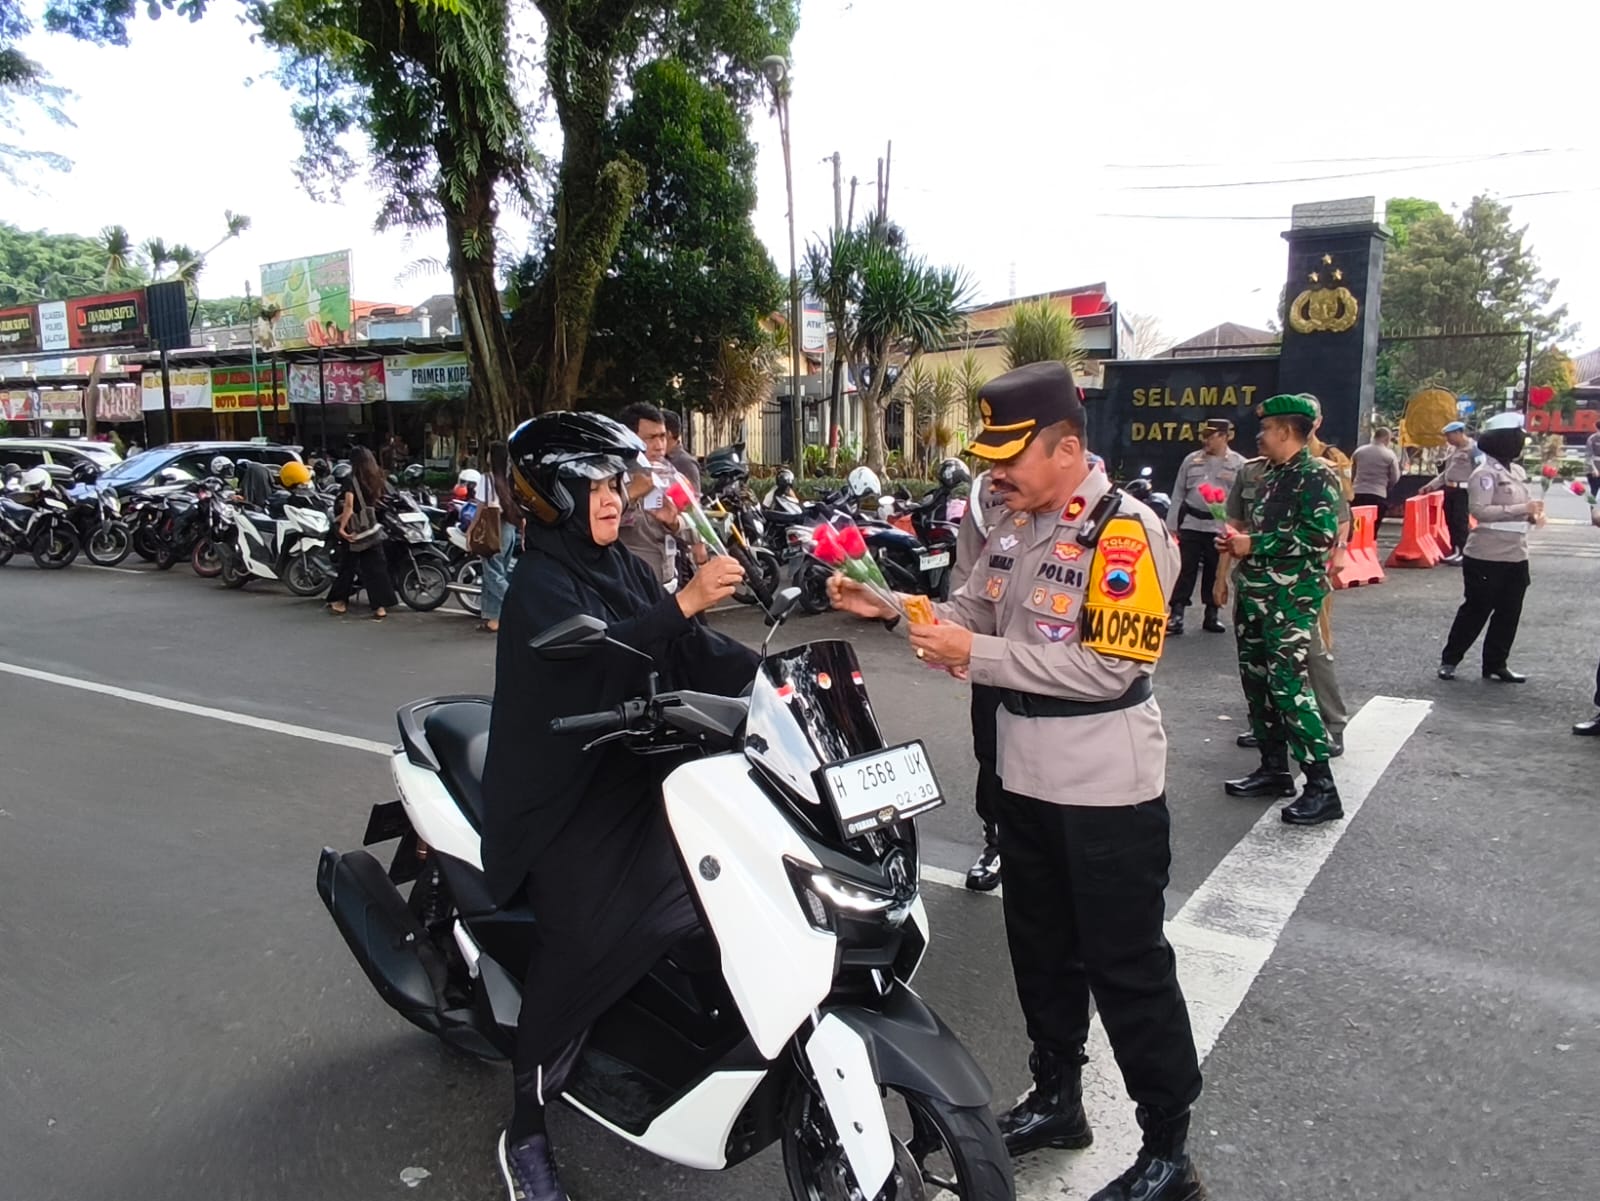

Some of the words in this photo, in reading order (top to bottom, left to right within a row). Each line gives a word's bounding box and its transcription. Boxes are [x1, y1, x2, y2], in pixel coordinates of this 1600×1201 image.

[411, 368, 446, 384] PRIMER
[1132, 385, 1257, 407] SELAMAT
[1037, 562, 1083, 588] POLRI
[1107, 609, 1141, 649] OPS
[832, 775, 848, 799] H
[857, 760, 897, 791] 2568
[903, 751, 926, 776] UK
